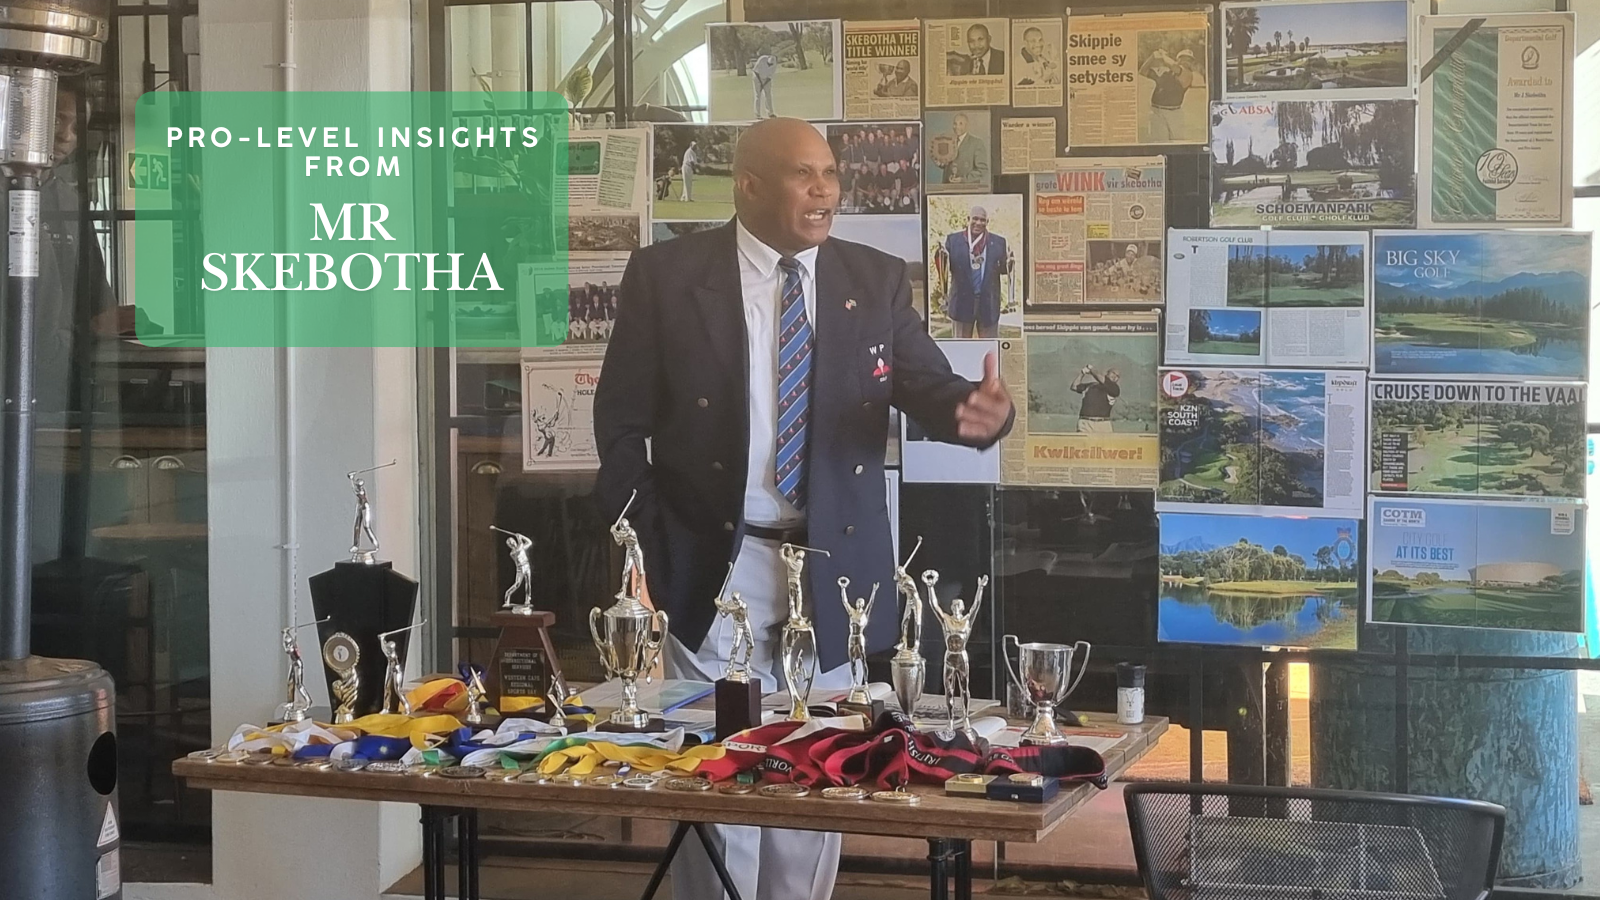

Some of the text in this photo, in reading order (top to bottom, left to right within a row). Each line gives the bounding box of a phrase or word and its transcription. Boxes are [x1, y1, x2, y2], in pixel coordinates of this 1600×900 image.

[846, 33, 917, 46] SKEBOTHA THE
[1069, 33, 1122, 50] Skippie
[846, 45, 917, 57] TITLE WINNER
[1069, 54, 1127, 67] smee sy
[1069, 69, 1134, 86] setysters
[1507, 76, 1543, 87] Awarded
[1239, 105, 1272, 115] ABSA
[1056, 171, 1106, 192] WINK
[1106, 178, 1118, 188] vir
[1256, 203, 1375, 214] SCHOEMANPARK
[1386, 250, 1460, 266] BIG SKY
[1414, 266, 1451, 279] GOLF
[1374, 384, 1430, 400] CRUISE
[1434, 384, 1480, 401] DOWN
[1484, 385, 1506, 402] TO
[1509, 386, 1541, 402] THE
[1180, 404, 1198, 412] KZN
[1167, 411, 1198, 419] SOUTH
[1168, 418, 1198, 426] COAST
[1033, 445, 1143, 460] Kwiksilwer!
[1383, 509, 1423, 519] COTM
[1402, 531, 1448, 547] CITY GOLF
[1395, 545, 1455, 561] AT ITS BEST
